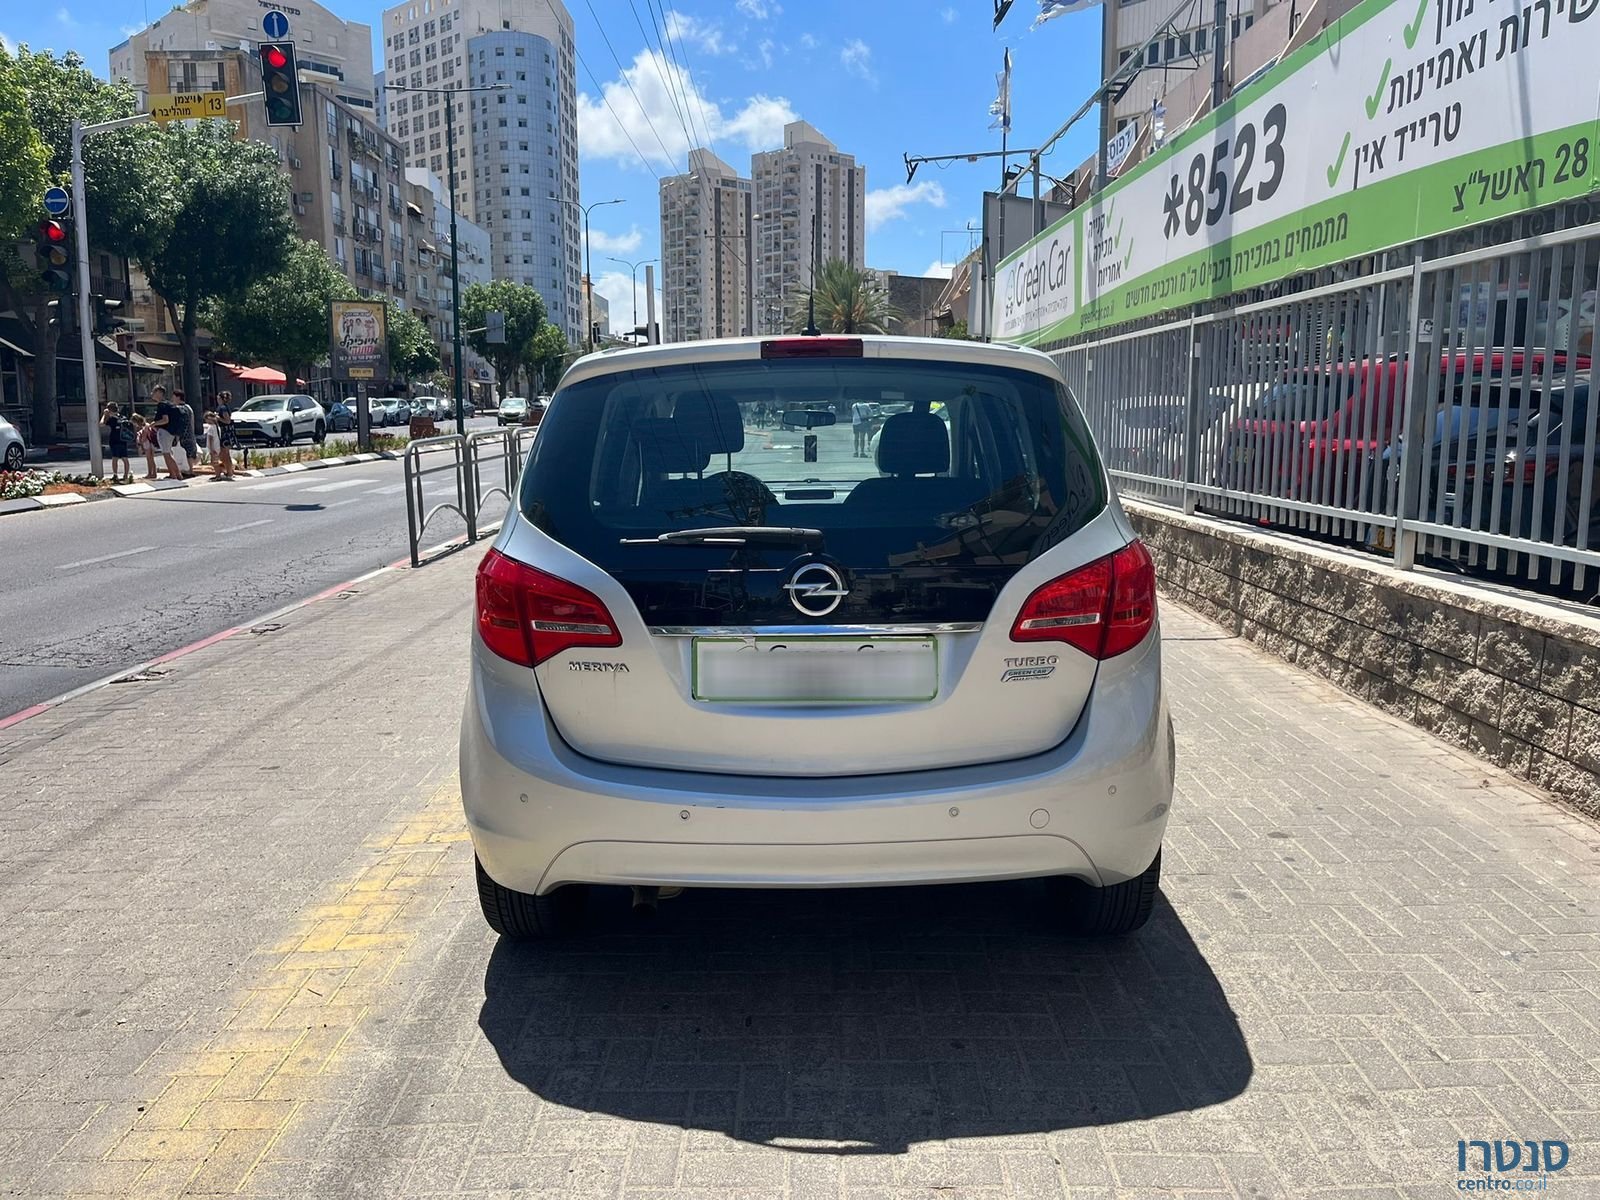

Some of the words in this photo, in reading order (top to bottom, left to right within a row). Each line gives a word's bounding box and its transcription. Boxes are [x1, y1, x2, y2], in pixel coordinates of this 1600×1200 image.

[1496, 0, 1600, 61] שירות
[1387, 29, 1488, 114] ואמינות
[158, 106, 191, 117] מוהליבר
[174, 95, 196, 107] ויצמן
[208, 97, 222, 111] 13
[1394, 102, 1462, 162] טרייד
[1353, 135, 1387, 190] אין
[1553, 137, 1590, 184] 28
[1093, 236, 1113, 262] מכירה
[1284, 212, 1349, 259] מתמחים
[1233, 238, 1280, 277] במכירת
[1016, 259, 1046, 307] Green
[1048, 239, 1071, 292] Car
[1097, 260, 1122, 288] אחריות
[1151, 273, 1178, 300] ורכבים
[1125, 283, 1150, 309] חדשים
[568, 661, 630, 672] MERIVA
[1004, 655, 1060, 667] TURBO
